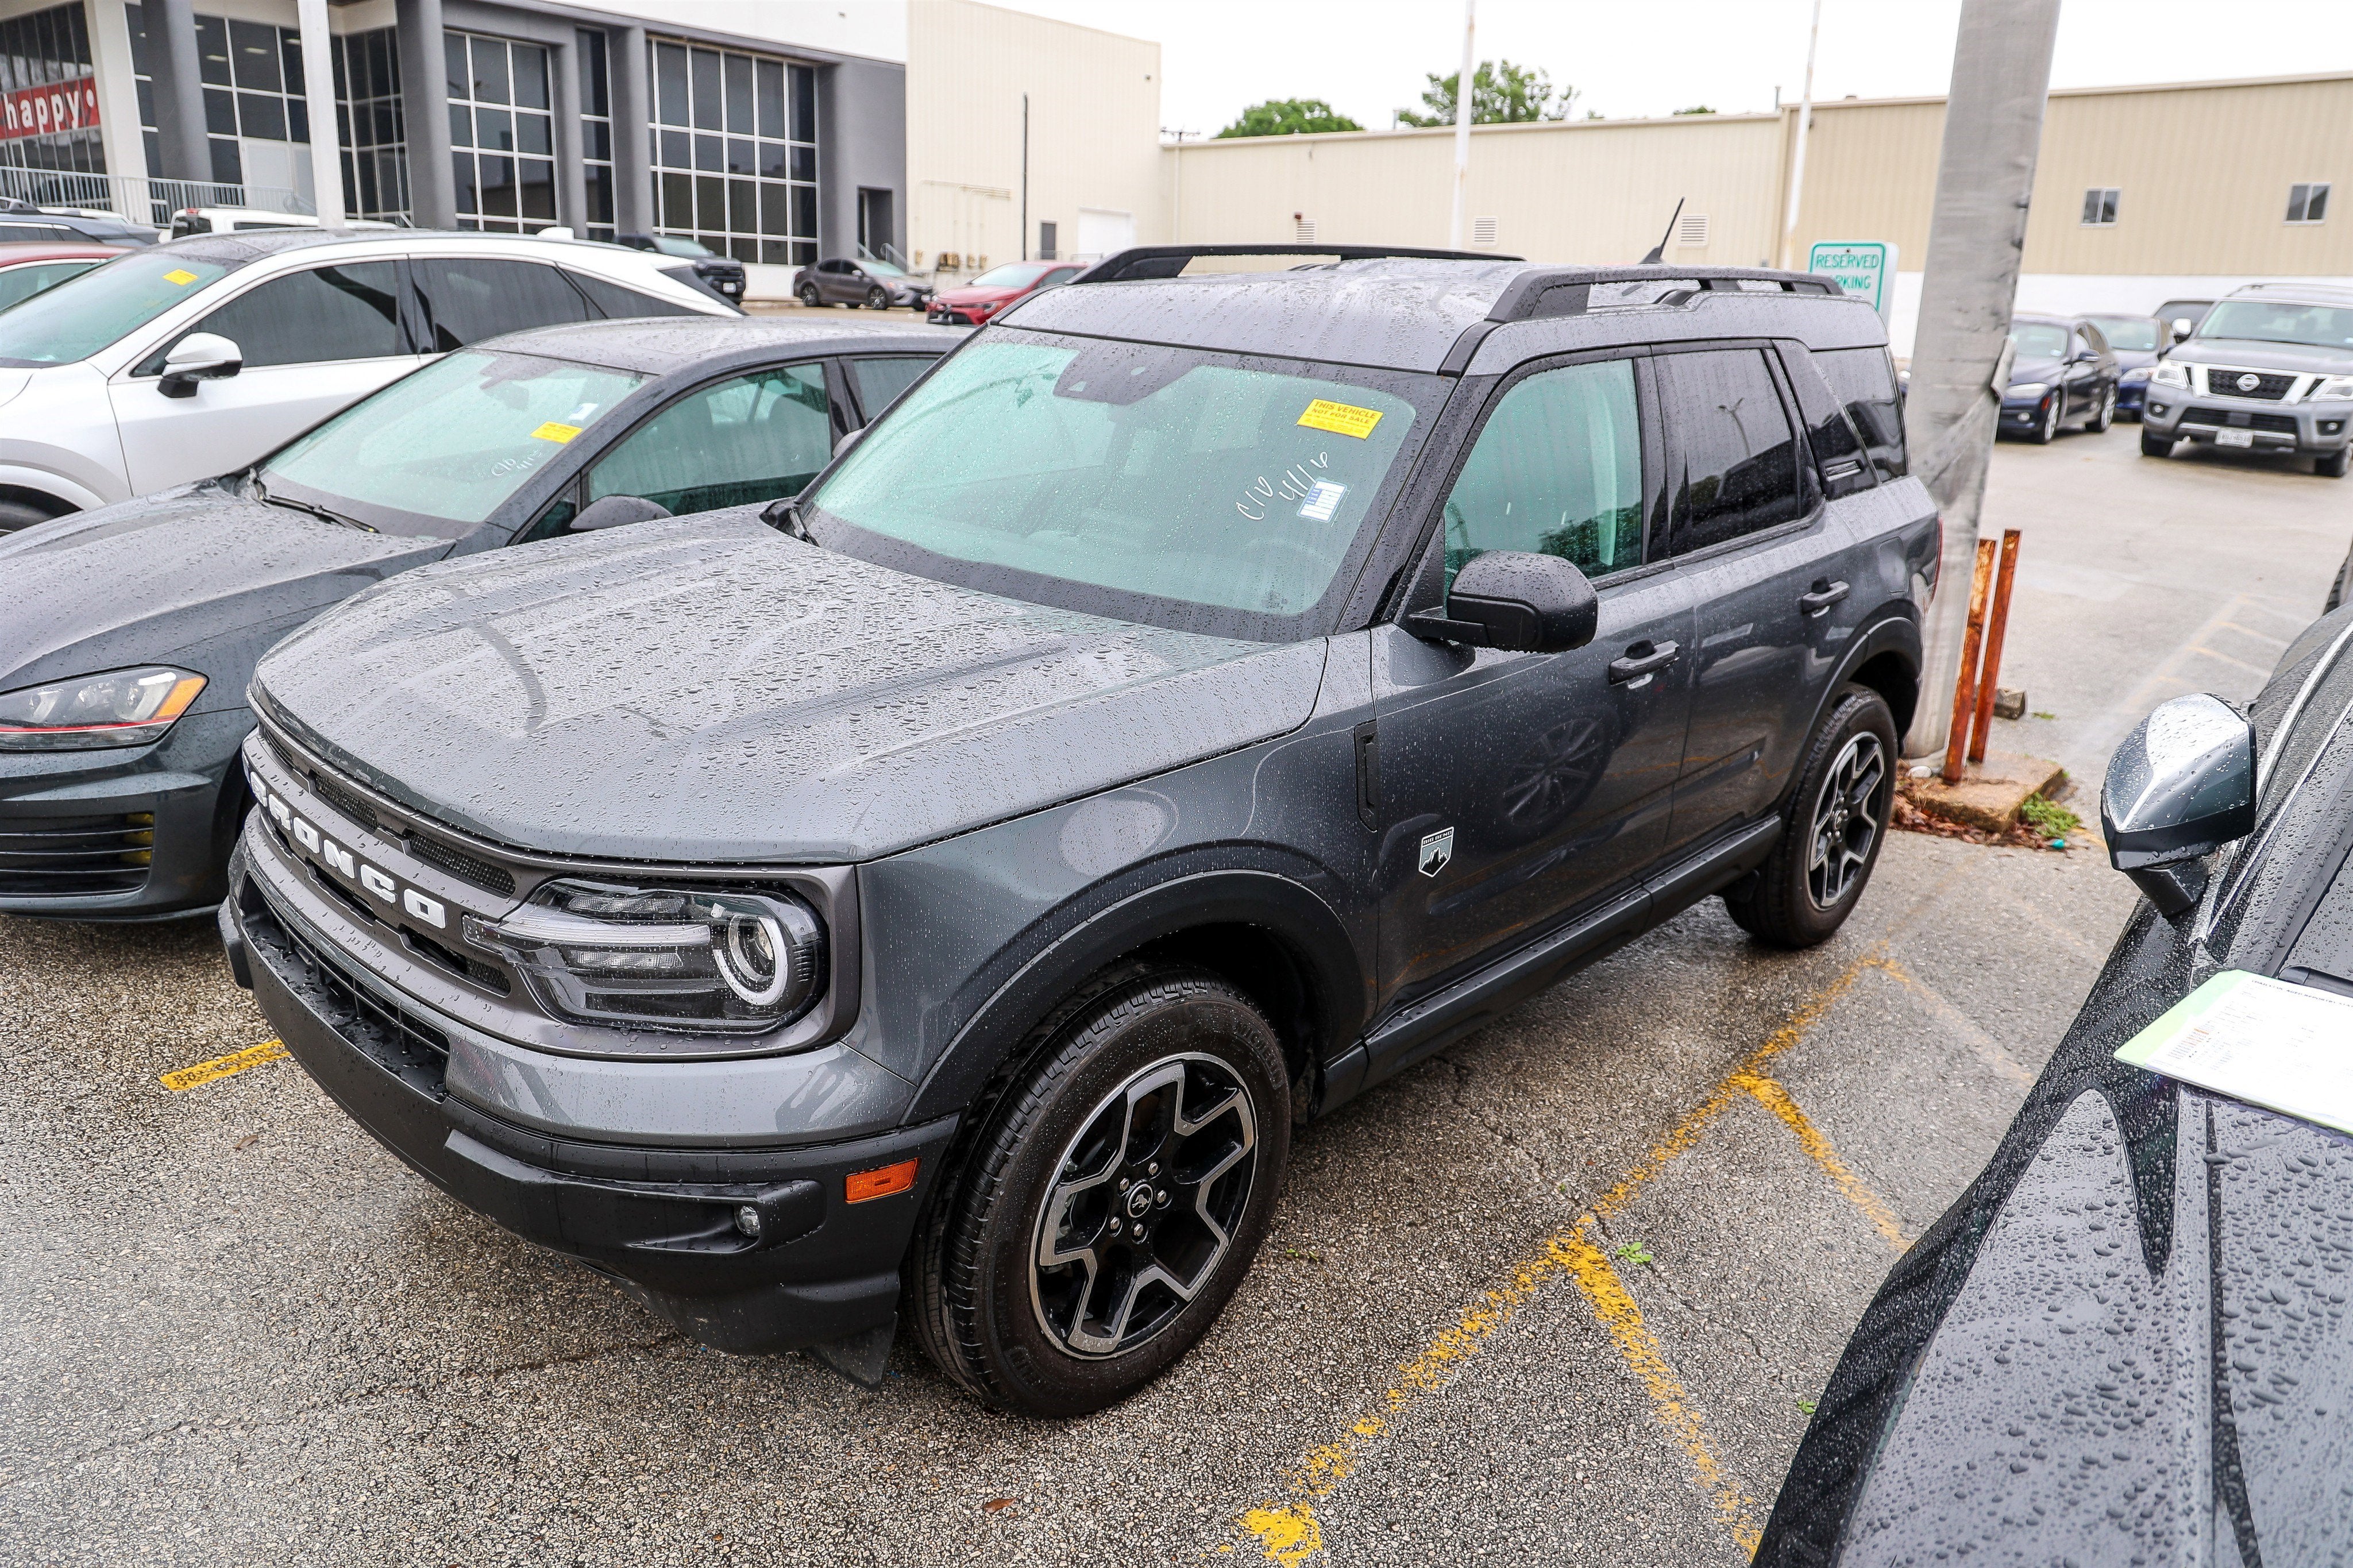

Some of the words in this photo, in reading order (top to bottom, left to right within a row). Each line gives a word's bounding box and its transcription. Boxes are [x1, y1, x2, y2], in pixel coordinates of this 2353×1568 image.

[3, 90, 80, 135] happy
[1815, 253, 1880, 268] RESERVED
[1833, 274, 1872, 289] RKING
[1314, 401, 1335, 410] THIS
[1337, 405, 1378, 419] VEHICLE
[1348, 416, 1371, 424] SALE
[1435, 831, 1452, 840] BEND
